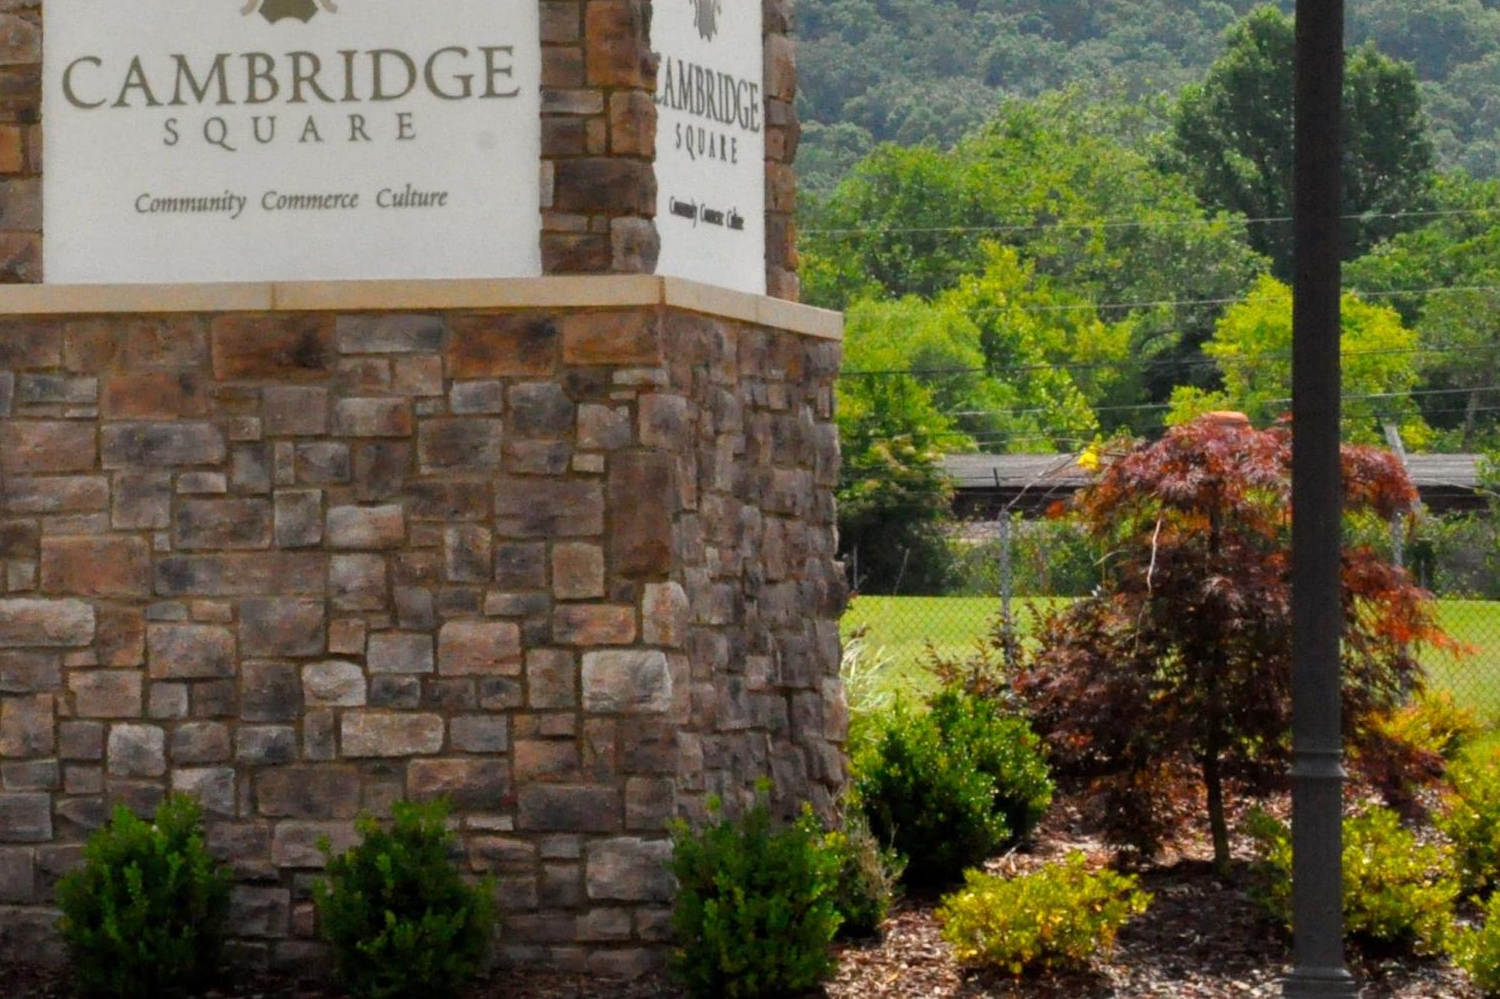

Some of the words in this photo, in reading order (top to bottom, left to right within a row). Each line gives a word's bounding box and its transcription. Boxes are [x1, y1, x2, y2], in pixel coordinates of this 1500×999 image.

[61, 45, 521, 109] CAMBRIDGE
[655, 56, 761, 133] AMBRIDGE
[163, 112, 417, 151] SQUARE
[675, 122, 738, 165] SQUARE
[134, 188, 247, 219] Community
[260, 189, 359, 212] Commerce
[375, 184, 449, 209] Culture
